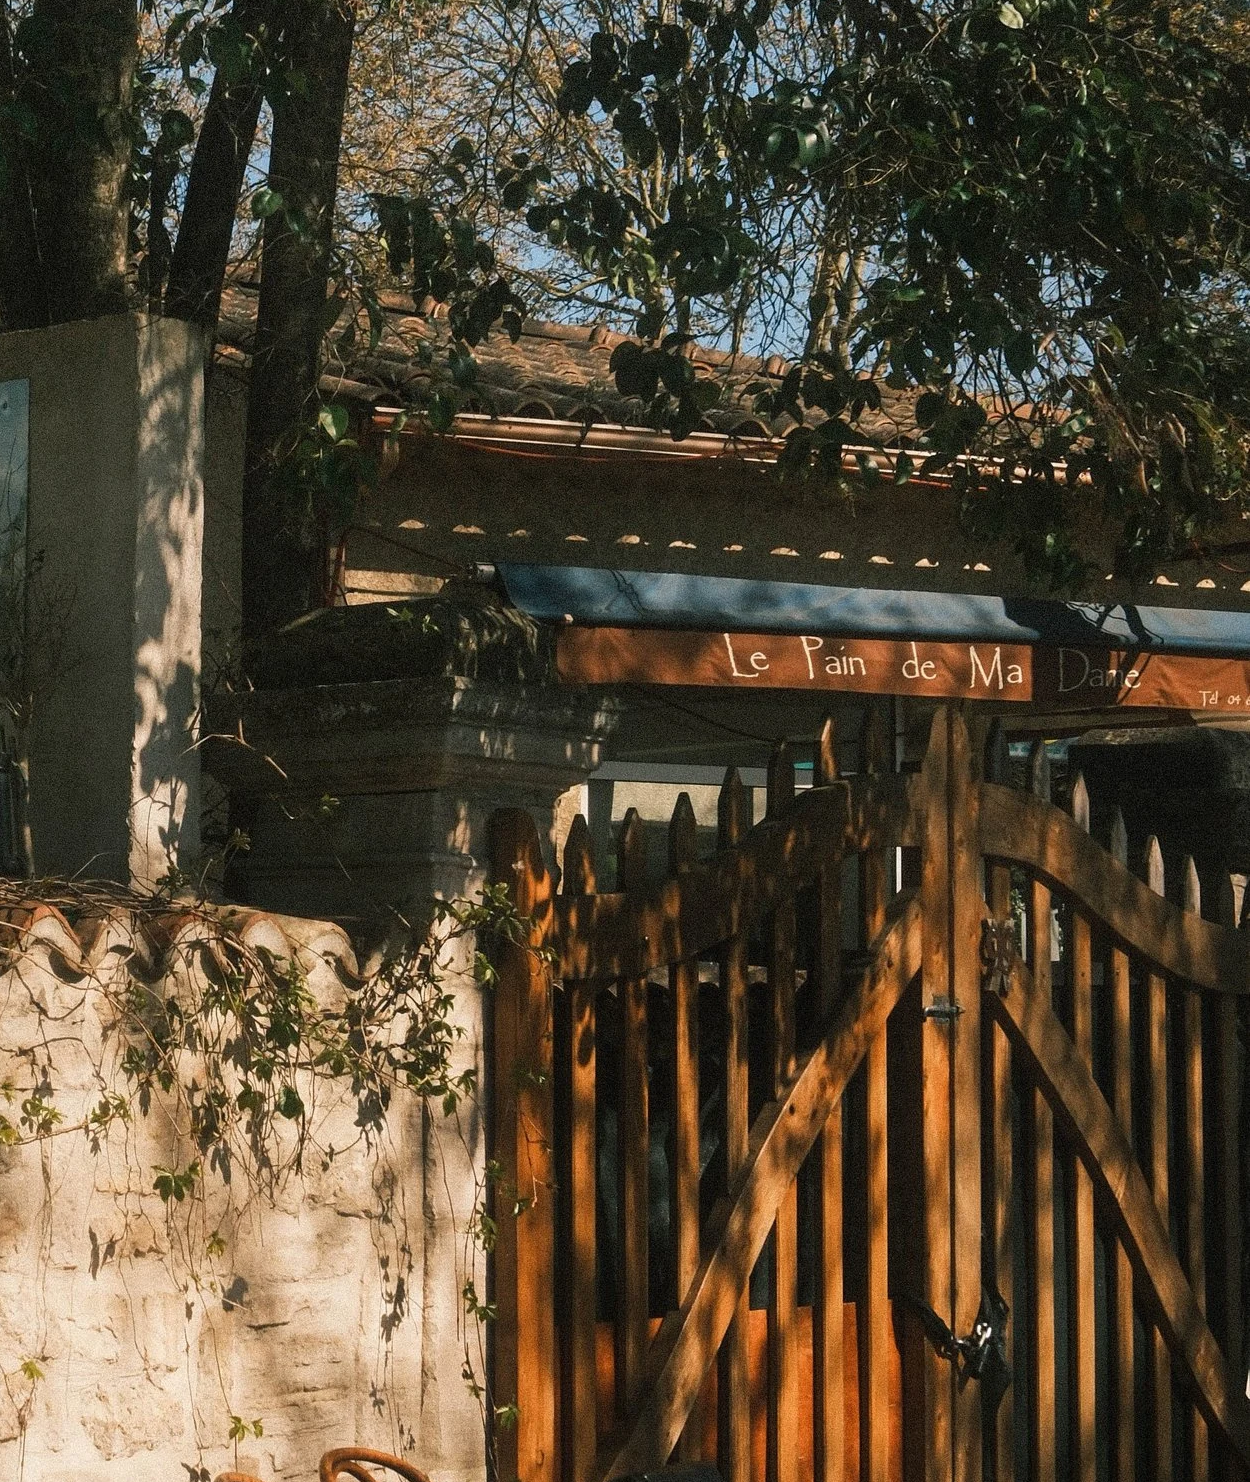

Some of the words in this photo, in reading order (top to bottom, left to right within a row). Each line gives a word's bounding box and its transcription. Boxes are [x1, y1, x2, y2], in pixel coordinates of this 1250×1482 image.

[724, 633, 769, 677] Le
[800, 635, 866, 679] Pain
[902, 642, 937, 679] de
[969, 646, 1023, 689] Ma
[1058, 647, 1141, 692] Dame
[1227, 695, 1241, 705] 04
